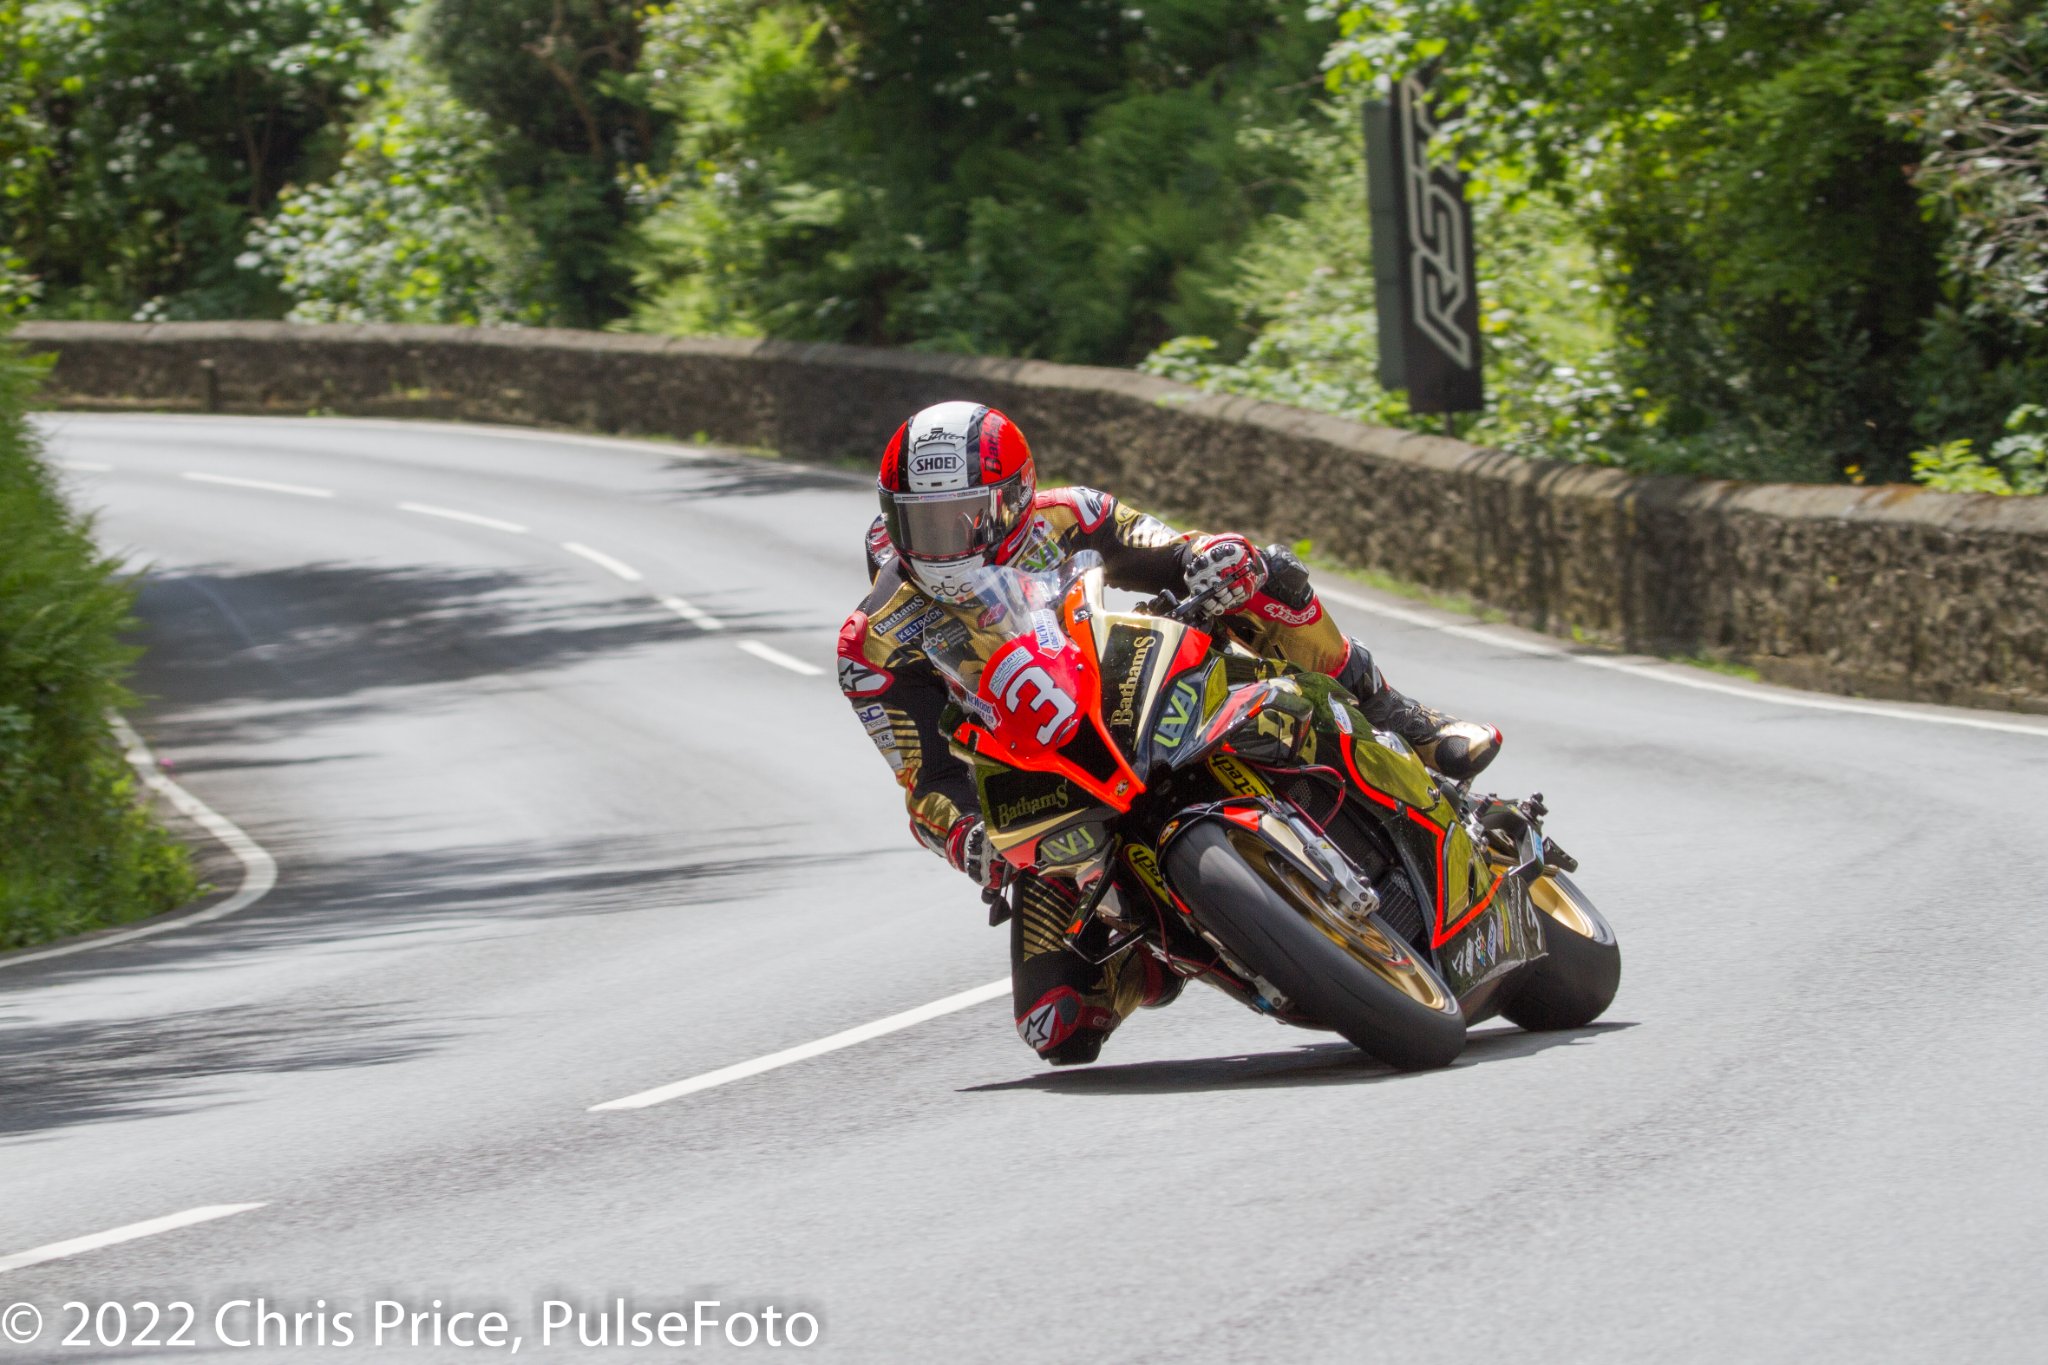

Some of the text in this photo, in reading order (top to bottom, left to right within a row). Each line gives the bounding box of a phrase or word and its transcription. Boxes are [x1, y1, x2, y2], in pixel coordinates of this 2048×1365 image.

[916, 455, 957, 472] SHOEI
[898, 608, 943, 641] KELTRUCK
[1006, 666, 1078, 746] 3
